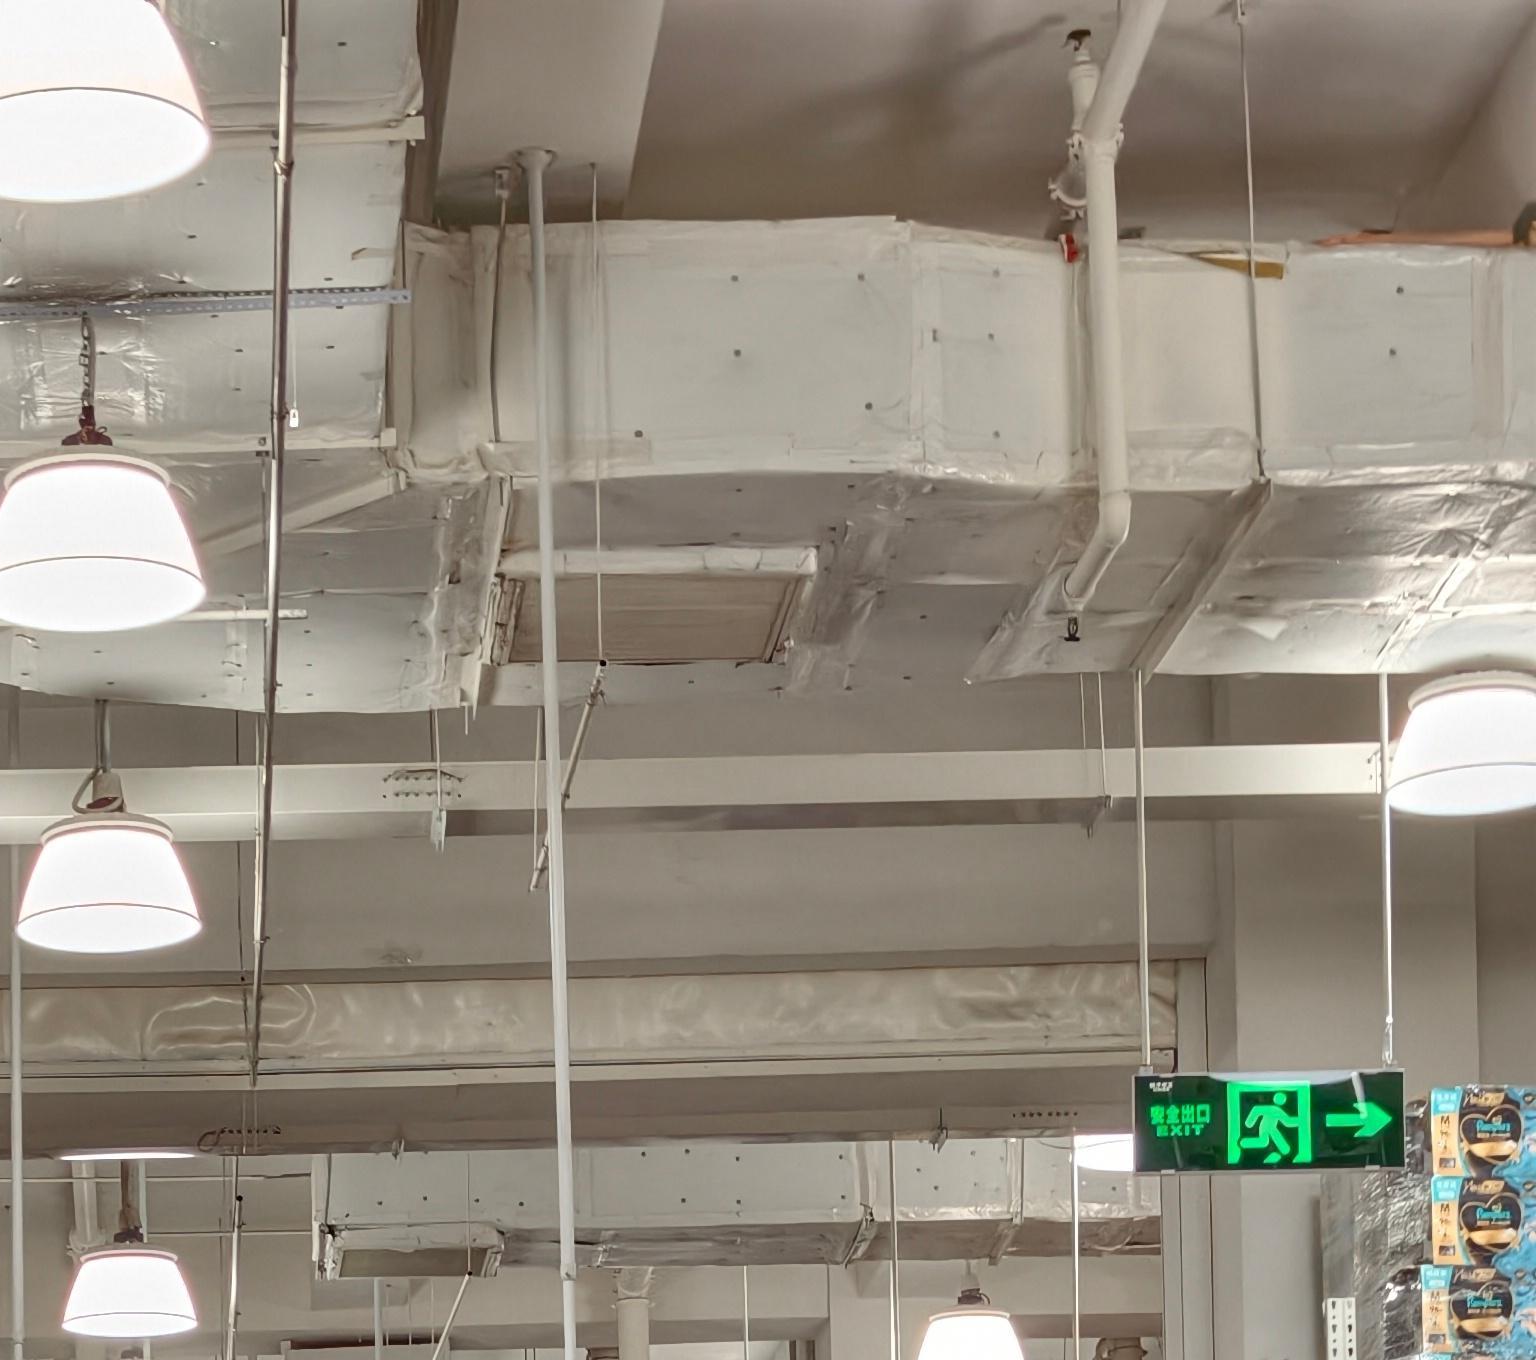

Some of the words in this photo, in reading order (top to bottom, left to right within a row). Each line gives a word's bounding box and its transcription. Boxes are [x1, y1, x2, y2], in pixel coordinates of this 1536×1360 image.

[1150, 1103, 1210, 1125] 安全出口
[1157, 1124, 1205, 1137] EXIT
